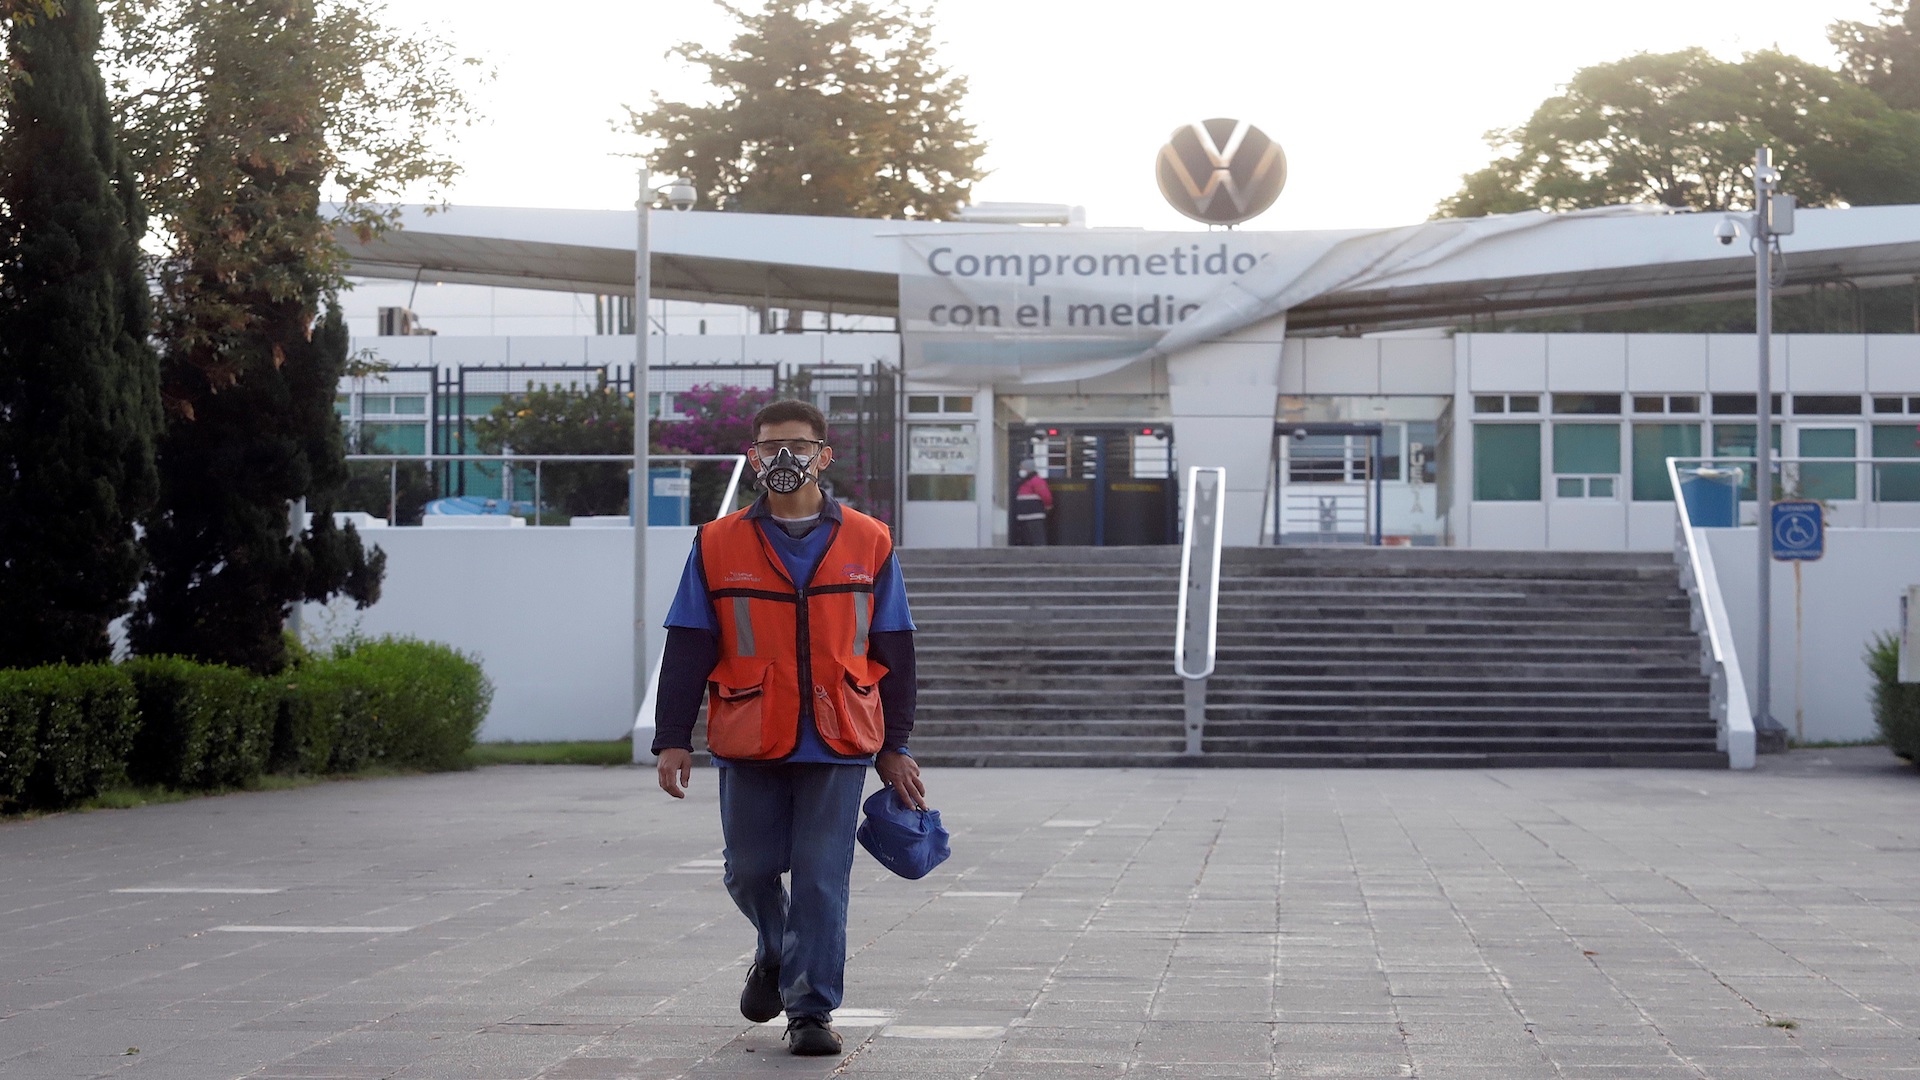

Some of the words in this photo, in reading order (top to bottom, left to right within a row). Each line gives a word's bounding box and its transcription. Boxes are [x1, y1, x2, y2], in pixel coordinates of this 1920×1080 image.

[928, 244, 1270, 286] Comprometido
[928, 304, 1000, 327] con
[1016, 294, 1051, 328] el
[911, 435, 969, 446] ENTRADA
[918, 450, 965, 460] PUERTA
